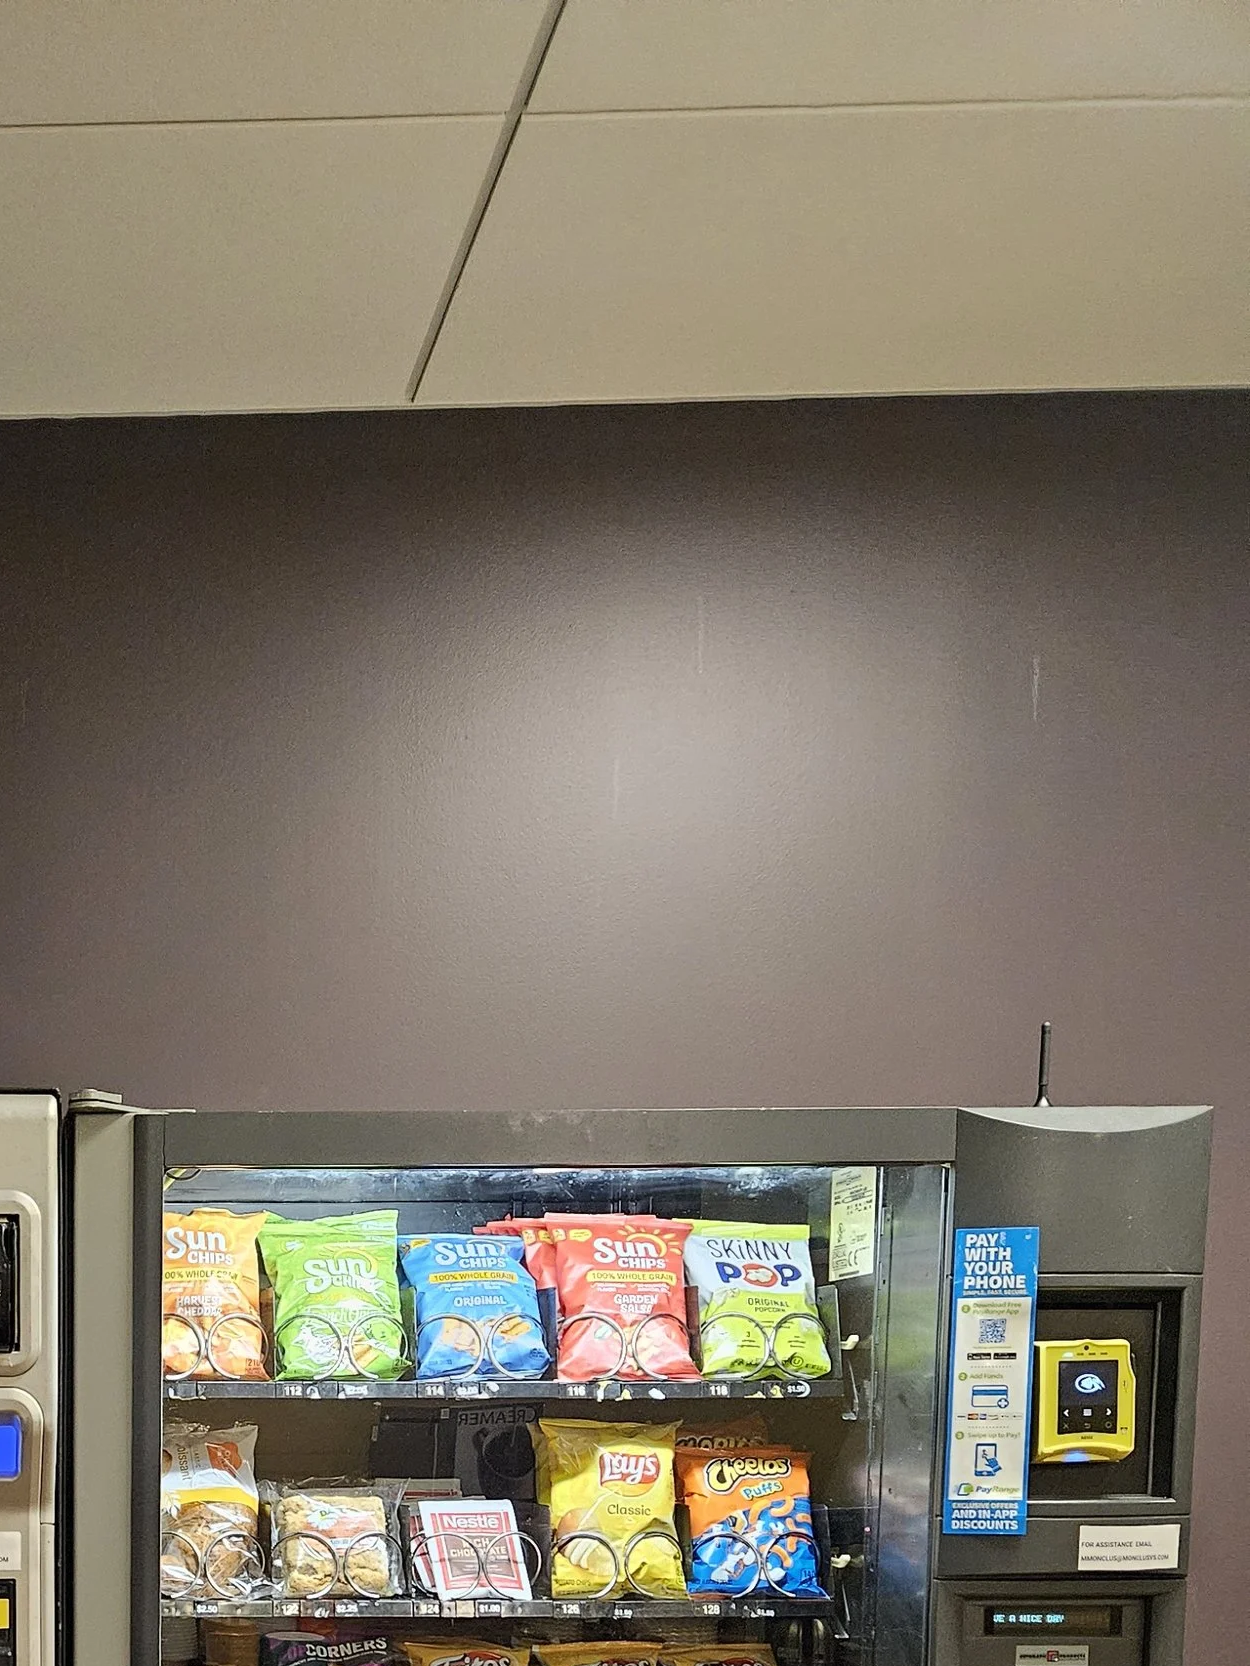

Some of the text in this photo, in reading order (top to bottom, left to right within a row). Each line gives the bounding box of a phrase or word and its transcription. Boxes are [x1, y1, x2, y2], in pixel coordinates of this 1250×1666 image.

[166, 1227, 226, 1260] Sun
[966, 1233, 999, 1247] PAY
[187, 1250, 234, 1265] CHIPS
[434, 1240, 503, 1266] Sun
[593, 1238, 658, 1263] Sun
[964, 1247, 1012, 1261] WITH
[458, 1256, 507, 1269] CHIPS
[617, 1256, 667, 1270] CHIPS
[963, 1261, 1014, 1275] YOUR
[303, 1257, 377, 1294] Sun
[432, 1272, 516, 1281] 100% WHOLE GRAIN
[592, 1271, 675, 1282] 100% WHOLE GRAIN
[715, 1261, 803, 1288] POP
[963, 1275, 1027, 1290] PHONE
[453, 1295, 507, 1306] ORIGINAL
[613, 1293, 659, 1305] GARDEN
[747, 1297, 791, 1308] ORIGINAL
[425, 1386, 444, 1396] 114
[705, 1456, 792, 1492] Cheetos
[741, 1480, 784, 1500] Puffs
[975, 1485, 1020, 1496] PayRange
[606, 1503, 652, 1517] Classic
[951, 1510, 1018, 1519] AND IN-APP
[951, 1519, 1019, 1530] DISCOUNTS
[479, 1604, 501, 1614] $1.00
[1008, 1614, 1016, 1623] A
[1019, 1614, 1043, 1623] NICE
[1046, 1614, 1065, 1623] DAY
